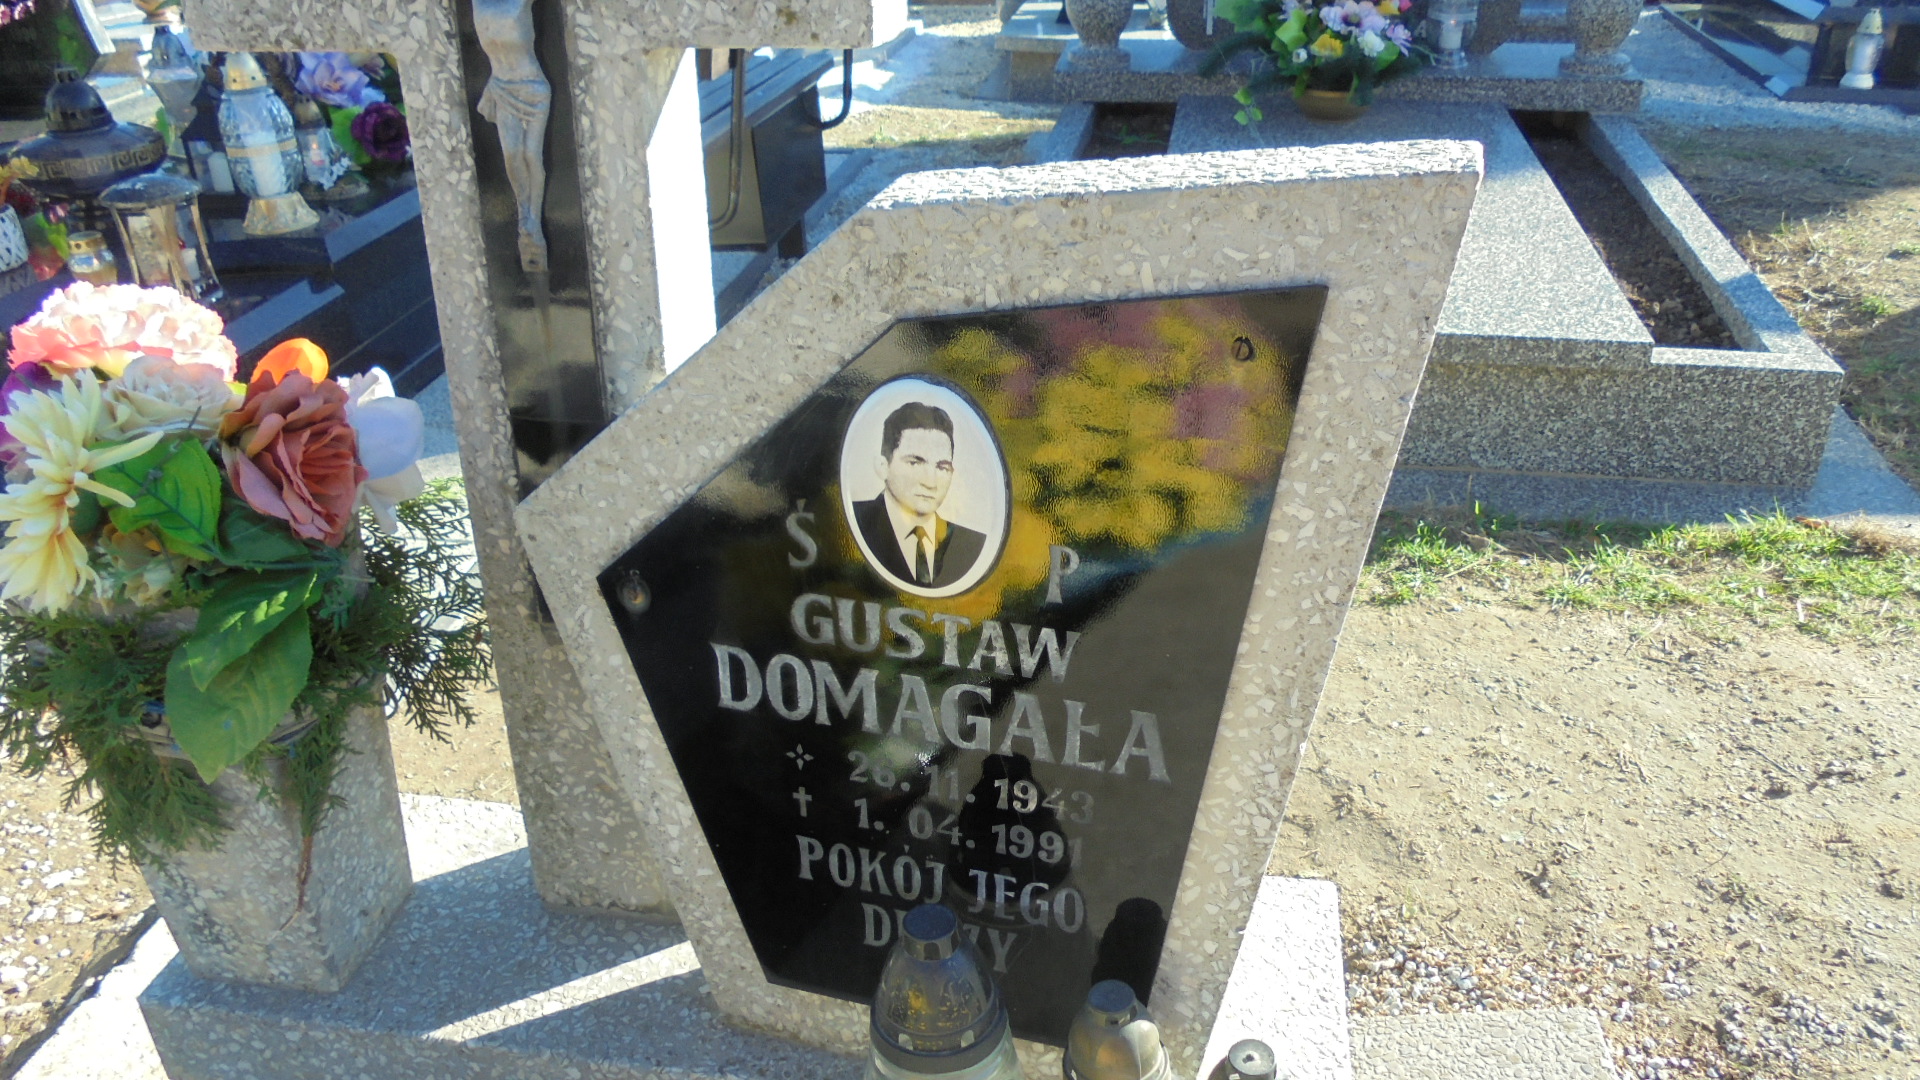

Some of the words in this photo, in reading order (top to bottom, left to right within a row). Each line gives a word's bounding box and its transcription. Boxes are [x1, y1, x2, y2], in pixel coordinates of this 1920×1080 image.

[785, 499, 818, 569] Ś
[1045, 545, 1079, 604] P
[791, 592, 1081, 683] GUSTAW
[710, 641, 1170, 785] DOMAGAŁA
[991, 824, 1082, 869] 1991
[994, 778, 1094, 824] 1943
[796, 834, 945, 903] POKÓJ
[968, 869, 1085, 934] JEGO
